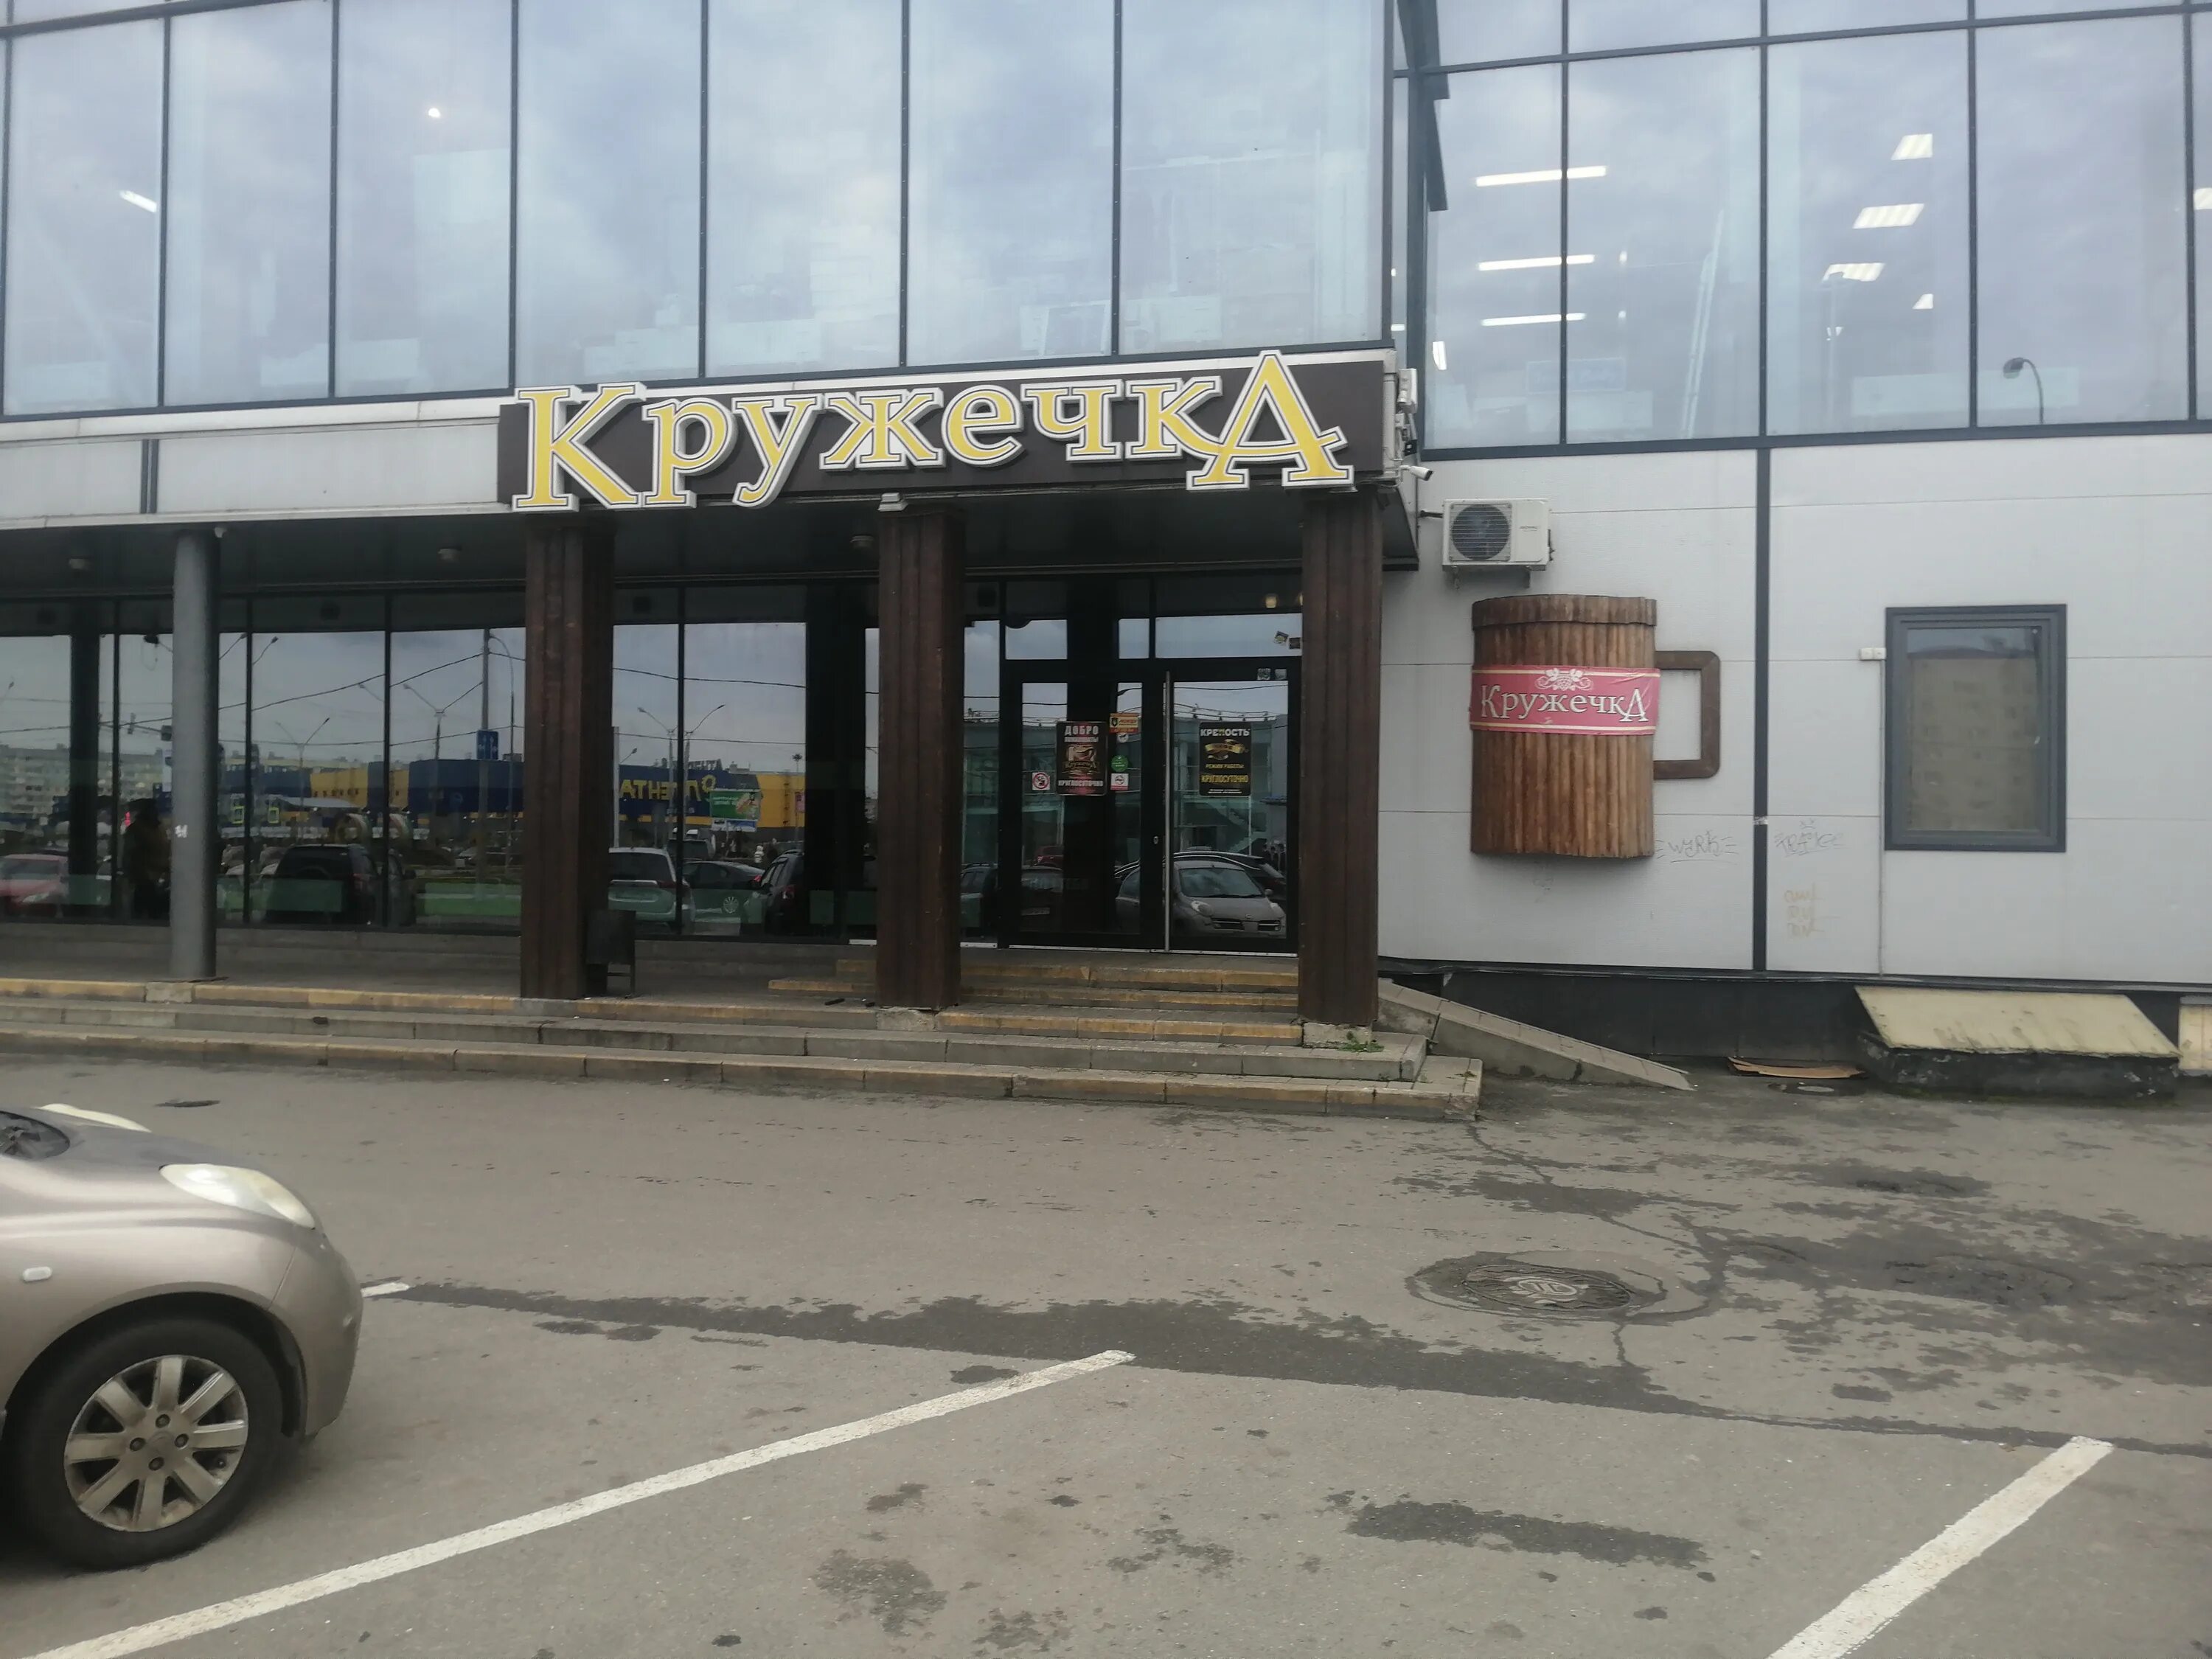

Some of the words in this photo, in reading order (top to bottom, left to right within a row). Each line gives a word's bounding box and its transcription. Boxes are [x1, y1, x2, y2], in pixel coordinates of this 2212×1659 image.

[512, 350, 1354, 512] КружечкА
[1481, 685, 1649, 723] КружечкА
[1064, 726, 1099, 736] ДОБРО
